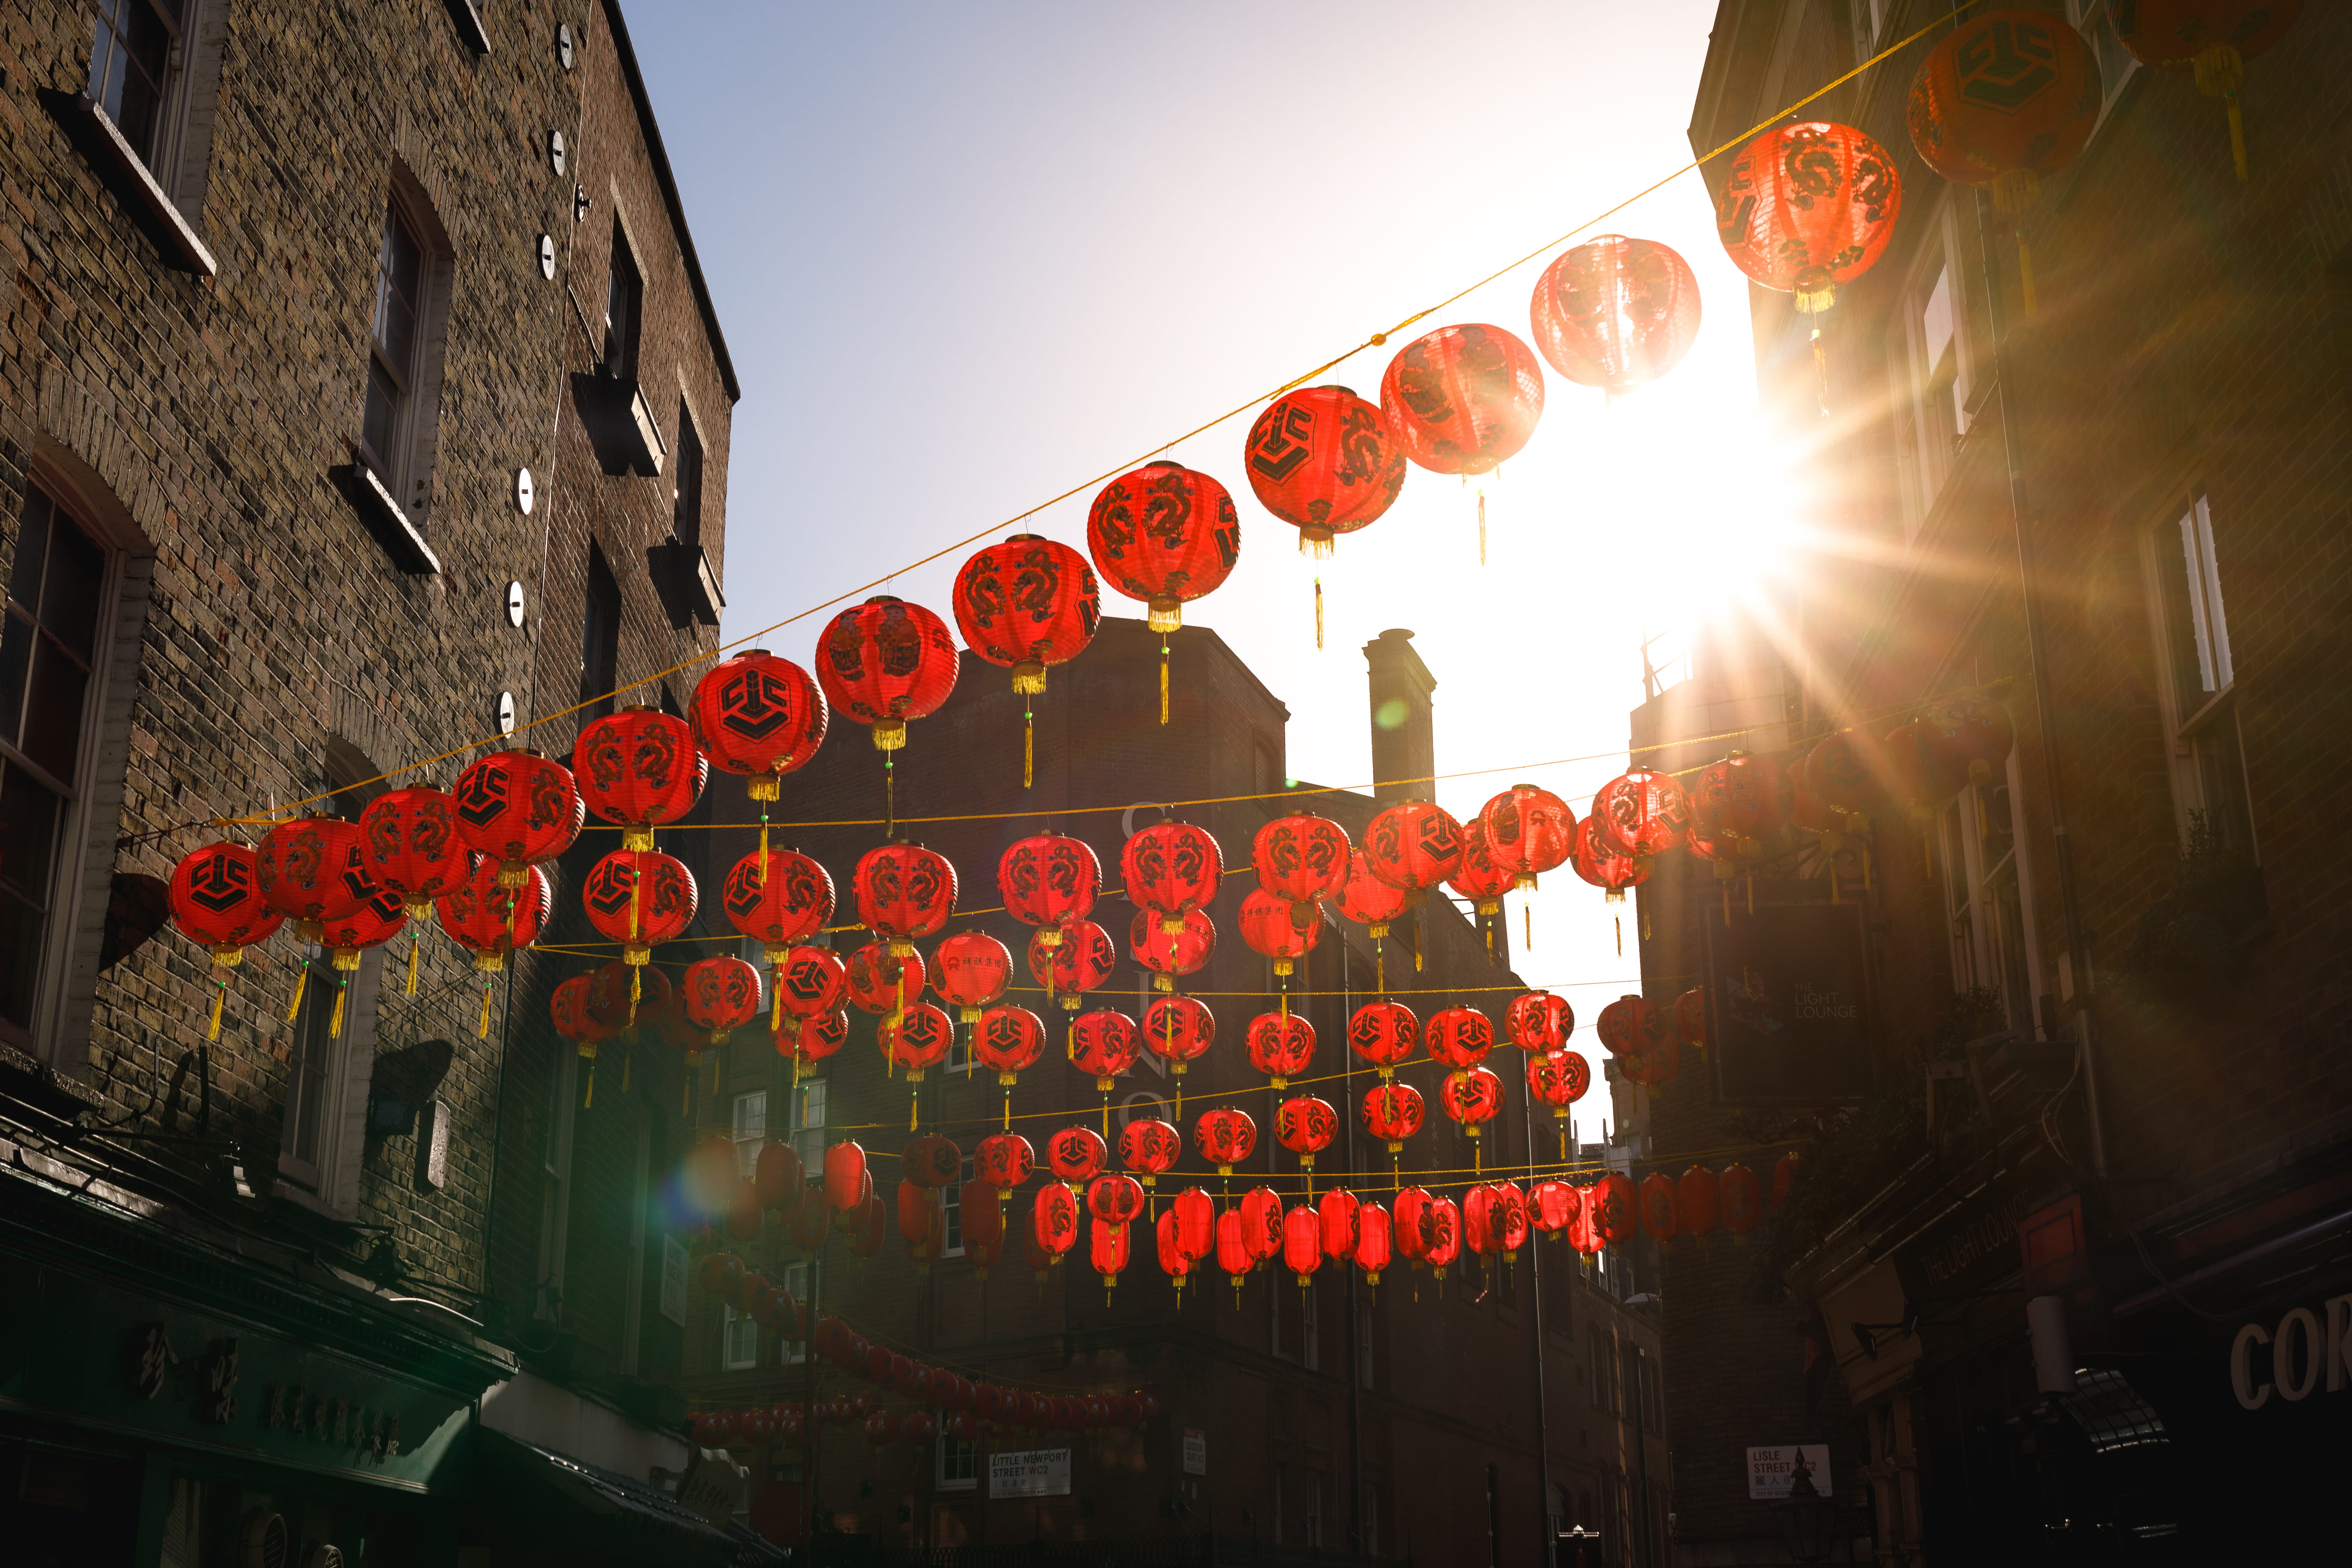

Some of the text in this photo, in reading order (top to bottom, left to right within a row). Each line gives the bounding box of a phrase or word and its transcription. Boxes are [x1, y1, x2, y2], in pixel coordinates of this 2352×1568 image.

[1794, 983, 1814, 991] THE
[1794, 992, 1838, 1005] LIGHT
[1796, 1005, 1859, 1019] LOUNGE
[1920, 1246, 1949, 1288] THE
[1943, 1223, 1981, 1274] LIGHT
[2231, 1293, 2352, 1410] COR
[1186, 1441, 1202, 1452] LEICESTER
[992, 1453, 1067, 1466] LITTLE NEWPORT
[1186, 1452, 1196, 1462] COURT
[1753, 1451, 1780, 1461] LISLE
[993, 1465, 1048, 1478] STREET WC2
[1754, 1462, 1791, 1473] STREET
